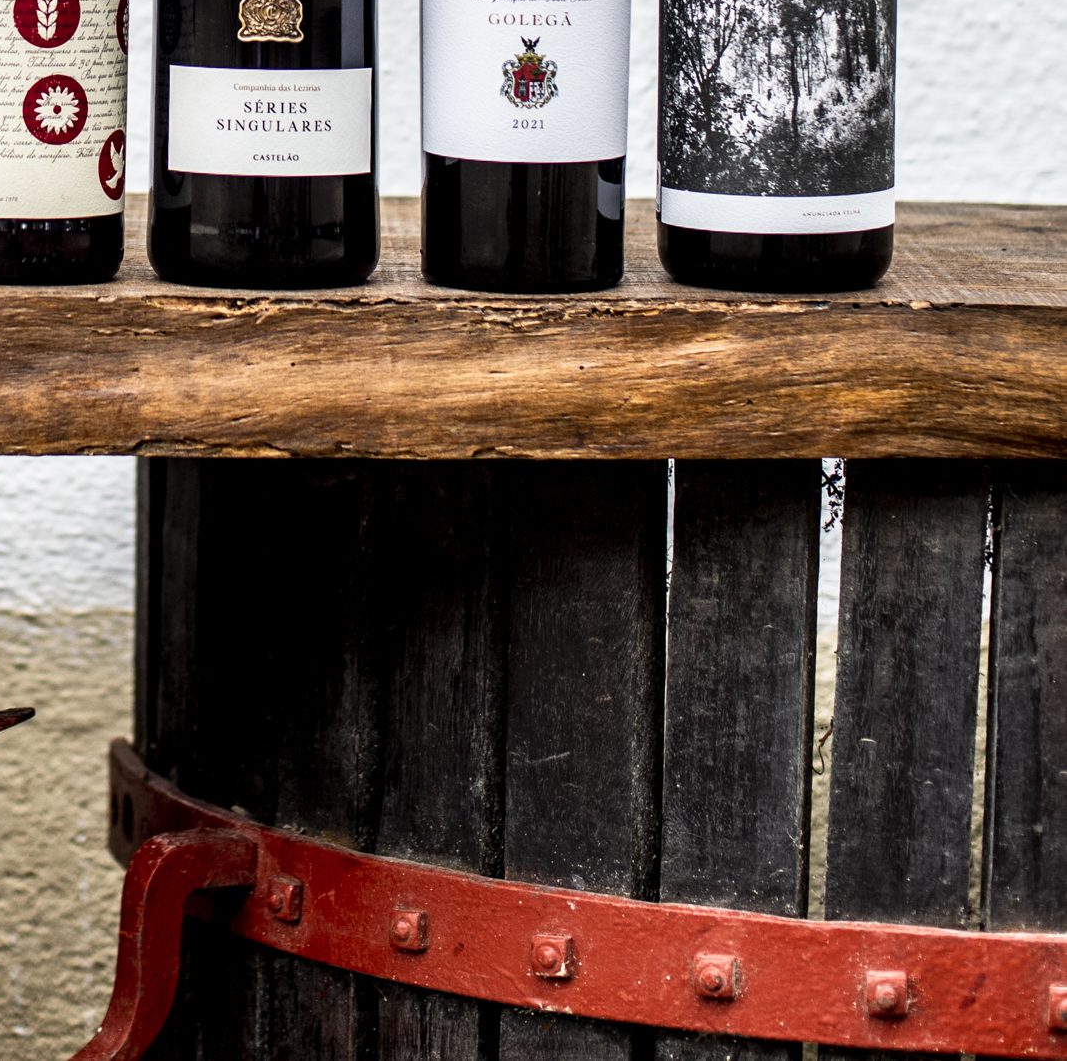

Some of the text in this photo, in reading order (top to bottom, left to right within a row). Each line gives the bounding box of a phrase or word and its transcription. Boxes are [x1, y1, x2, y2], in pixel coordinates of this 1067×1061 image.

[488, 11, 572, 27] GOLEGÃ
[233, 82, 276, 93] Companhia
[278, 84, 291, 92] das
[243, 99, 308, 114] SÉRIES
[216, 119, 332, 133] SINGULARES
[512, 119, 545, 129] 2021
[253, 152, 300, 162] CASTELÃO
